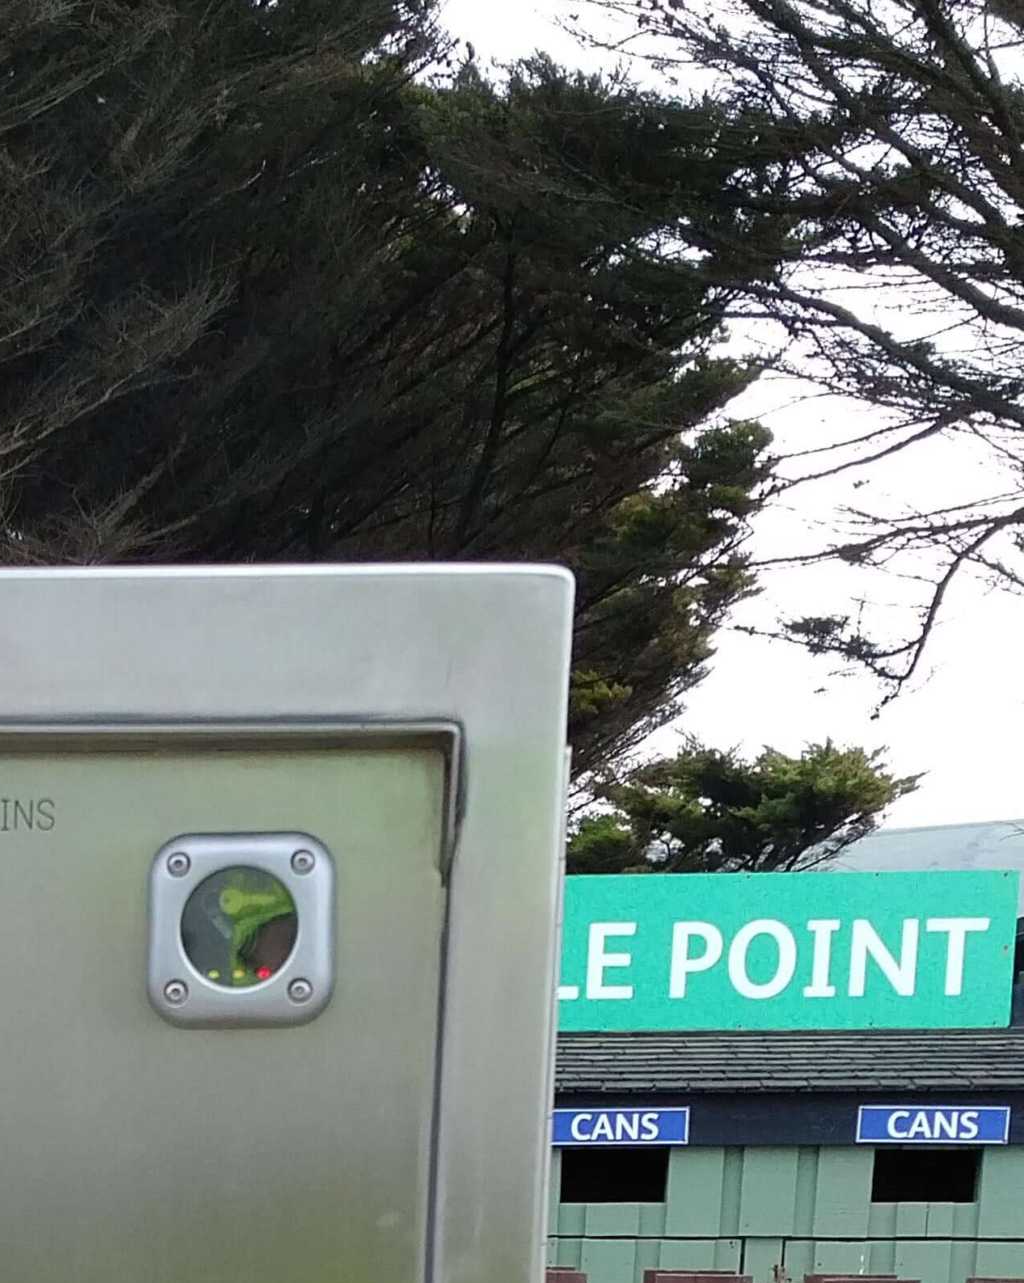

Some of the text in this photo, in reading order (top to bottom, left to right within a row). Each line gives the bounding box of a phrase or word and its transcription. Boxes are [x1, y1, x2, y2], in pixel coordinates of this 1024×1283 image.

[557, 918, 990, 1000] E POINT
[570, 1111, 660, 1142] CANS
[886, 1110, 979, 1139] CANS
